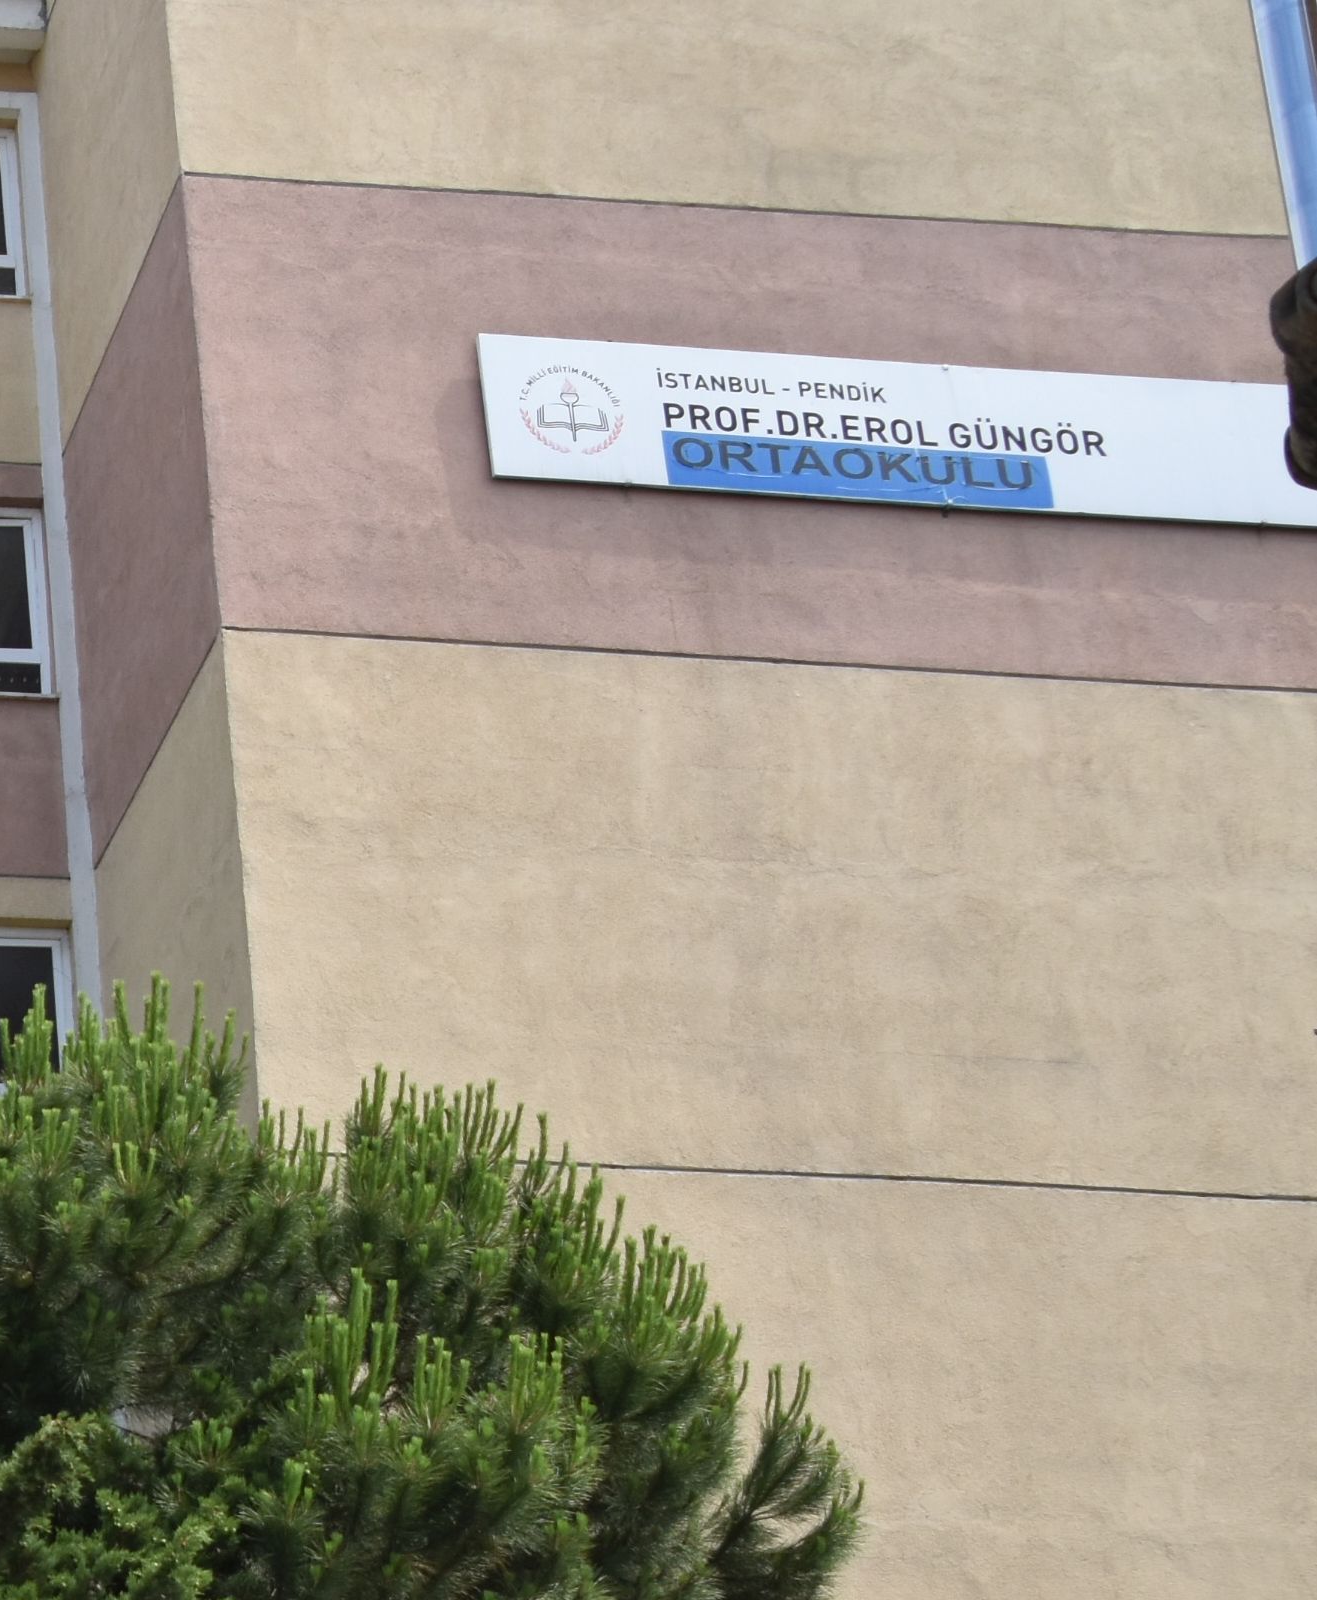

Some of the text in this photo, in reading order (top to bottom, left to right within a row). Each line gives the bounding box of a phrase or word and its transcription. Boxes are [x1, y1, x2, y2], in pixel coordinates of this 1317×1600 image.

[527, 368, 547, 387] MİLLİ
[547, 365, 579, 376] EĞİTİM
[581, 370, 621, 407] BAKANLIĞI
[656, 367, 775, 396] İSTANBUL
[798, 380, 888, 404] PENDİK
[948, 417, 1108, 457] GÜNGÖR
[671, 437, 1035, 490] ORTAOKULU
